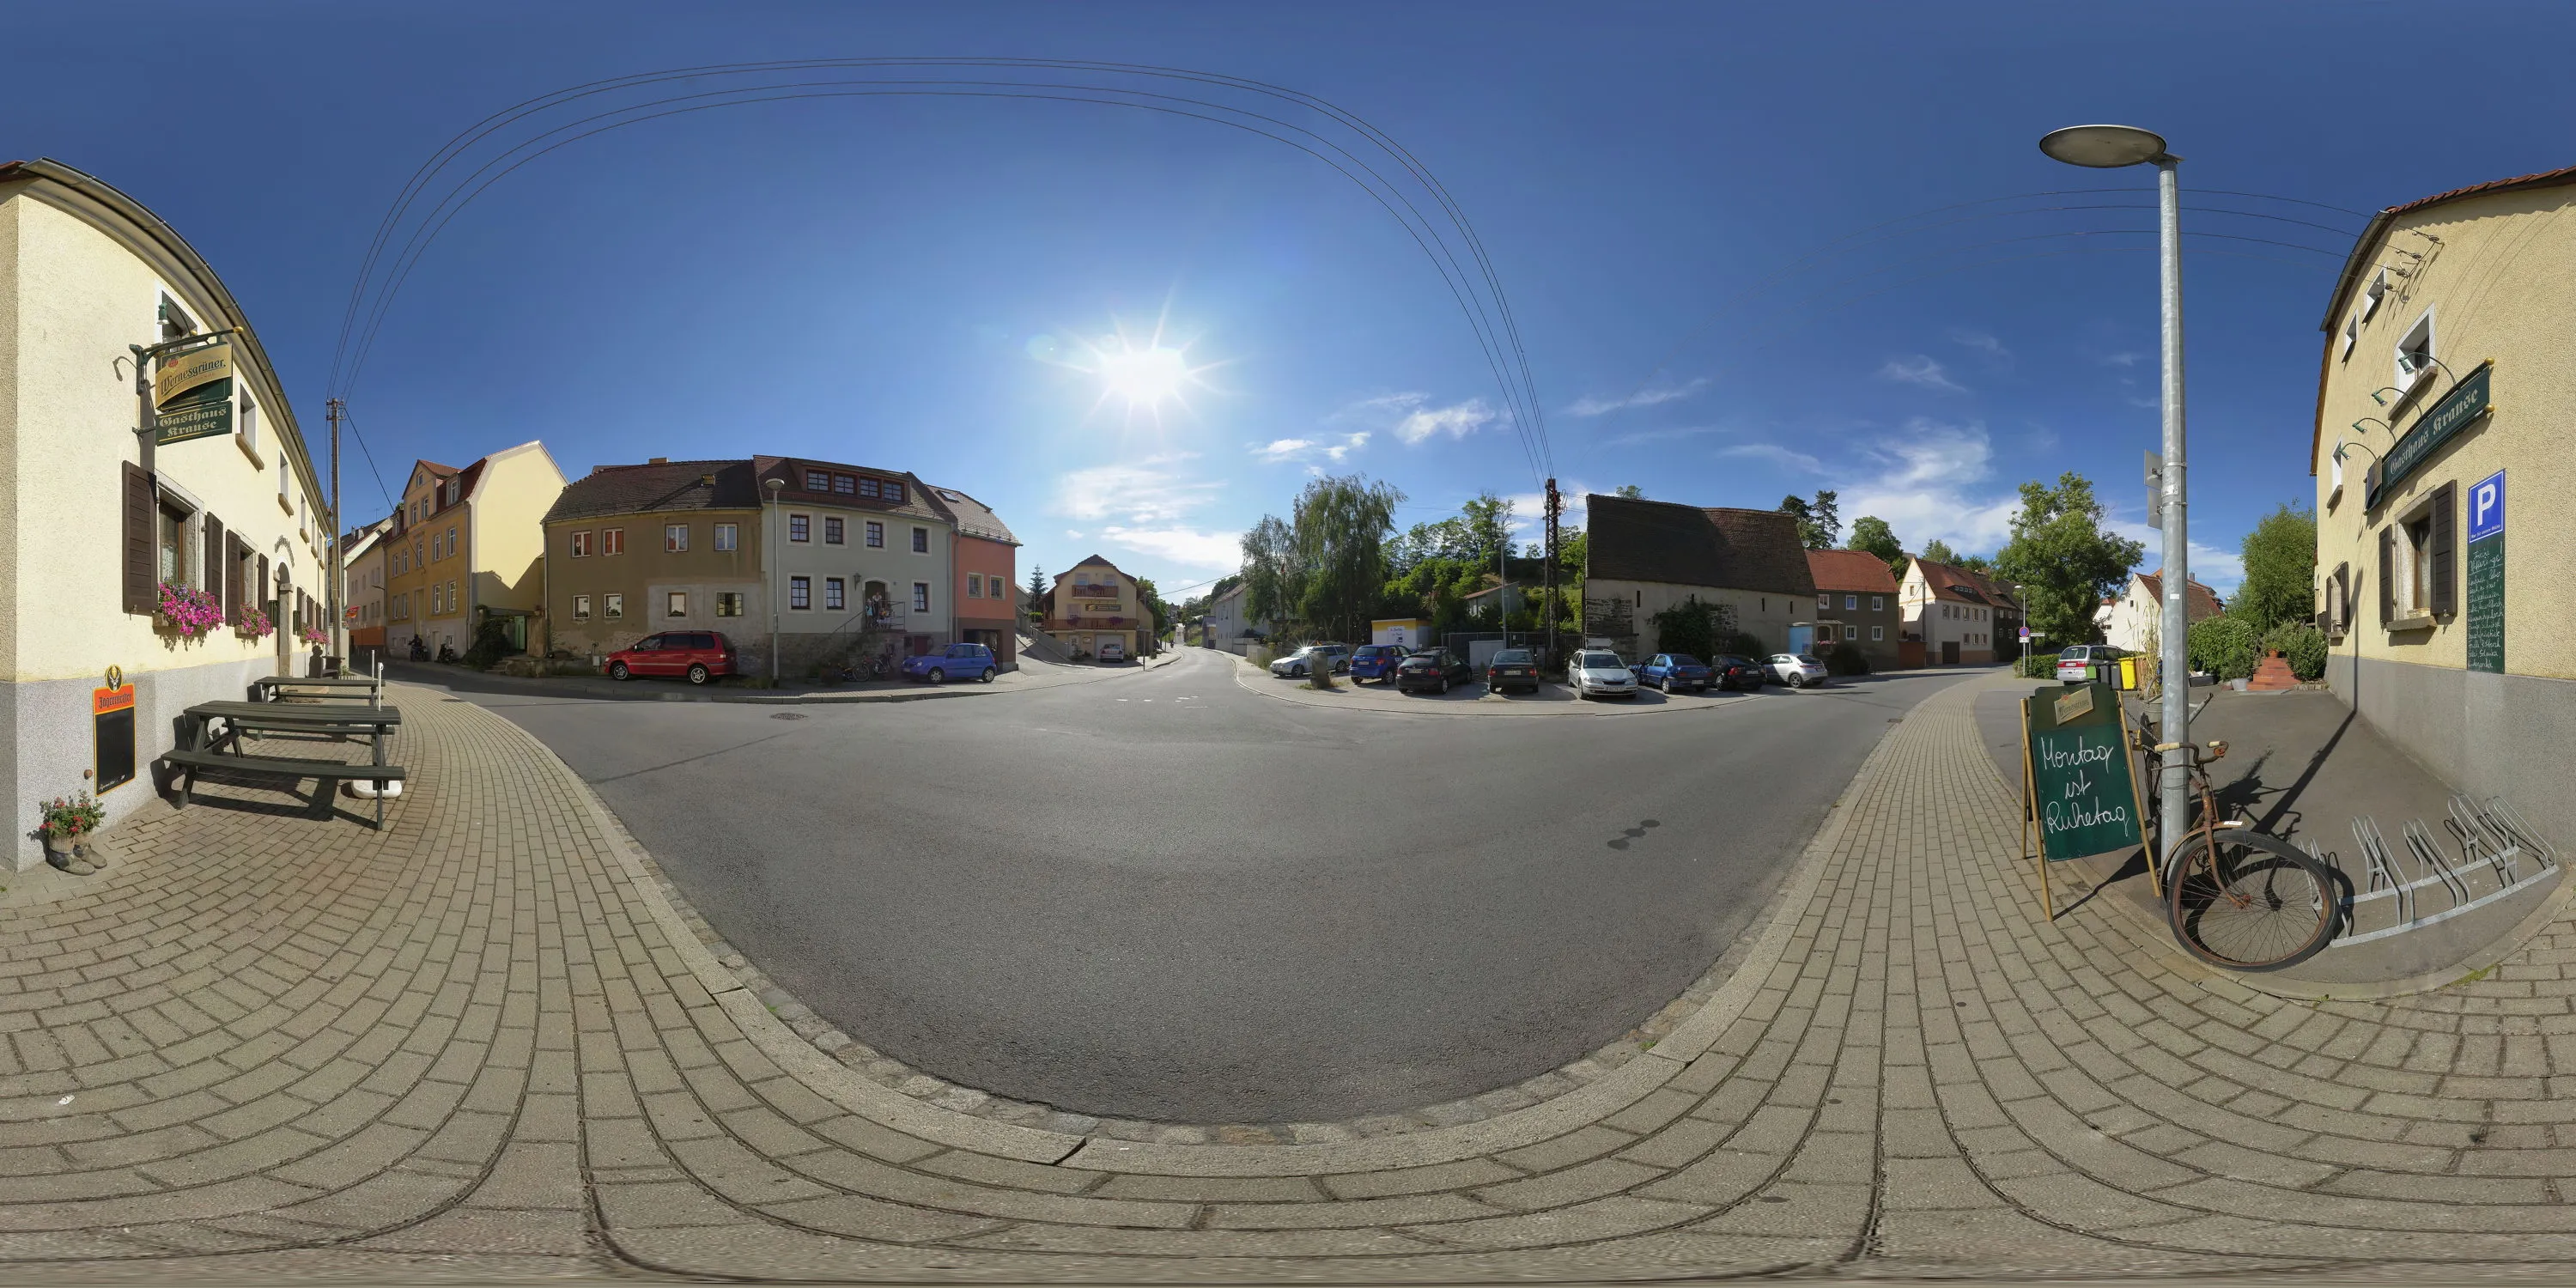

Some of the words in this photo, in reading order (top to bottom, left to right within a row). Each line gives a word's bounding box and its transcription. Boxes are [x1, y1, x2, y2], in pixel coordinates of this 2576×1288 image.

[159, 407, 227, 428] Gasthaus
[167, 421, 217, 437] Krause
[2390, 427, 2429, 475] Gasthaus
[2433, 388, 2478, 435] Krause
[2477, 483, 2496, 526] P
[2041, 735, 2113, 774] Montag
[2064, 769, 2091, 800] ist
[2046, 796, 2129, 837] Ruhetag
